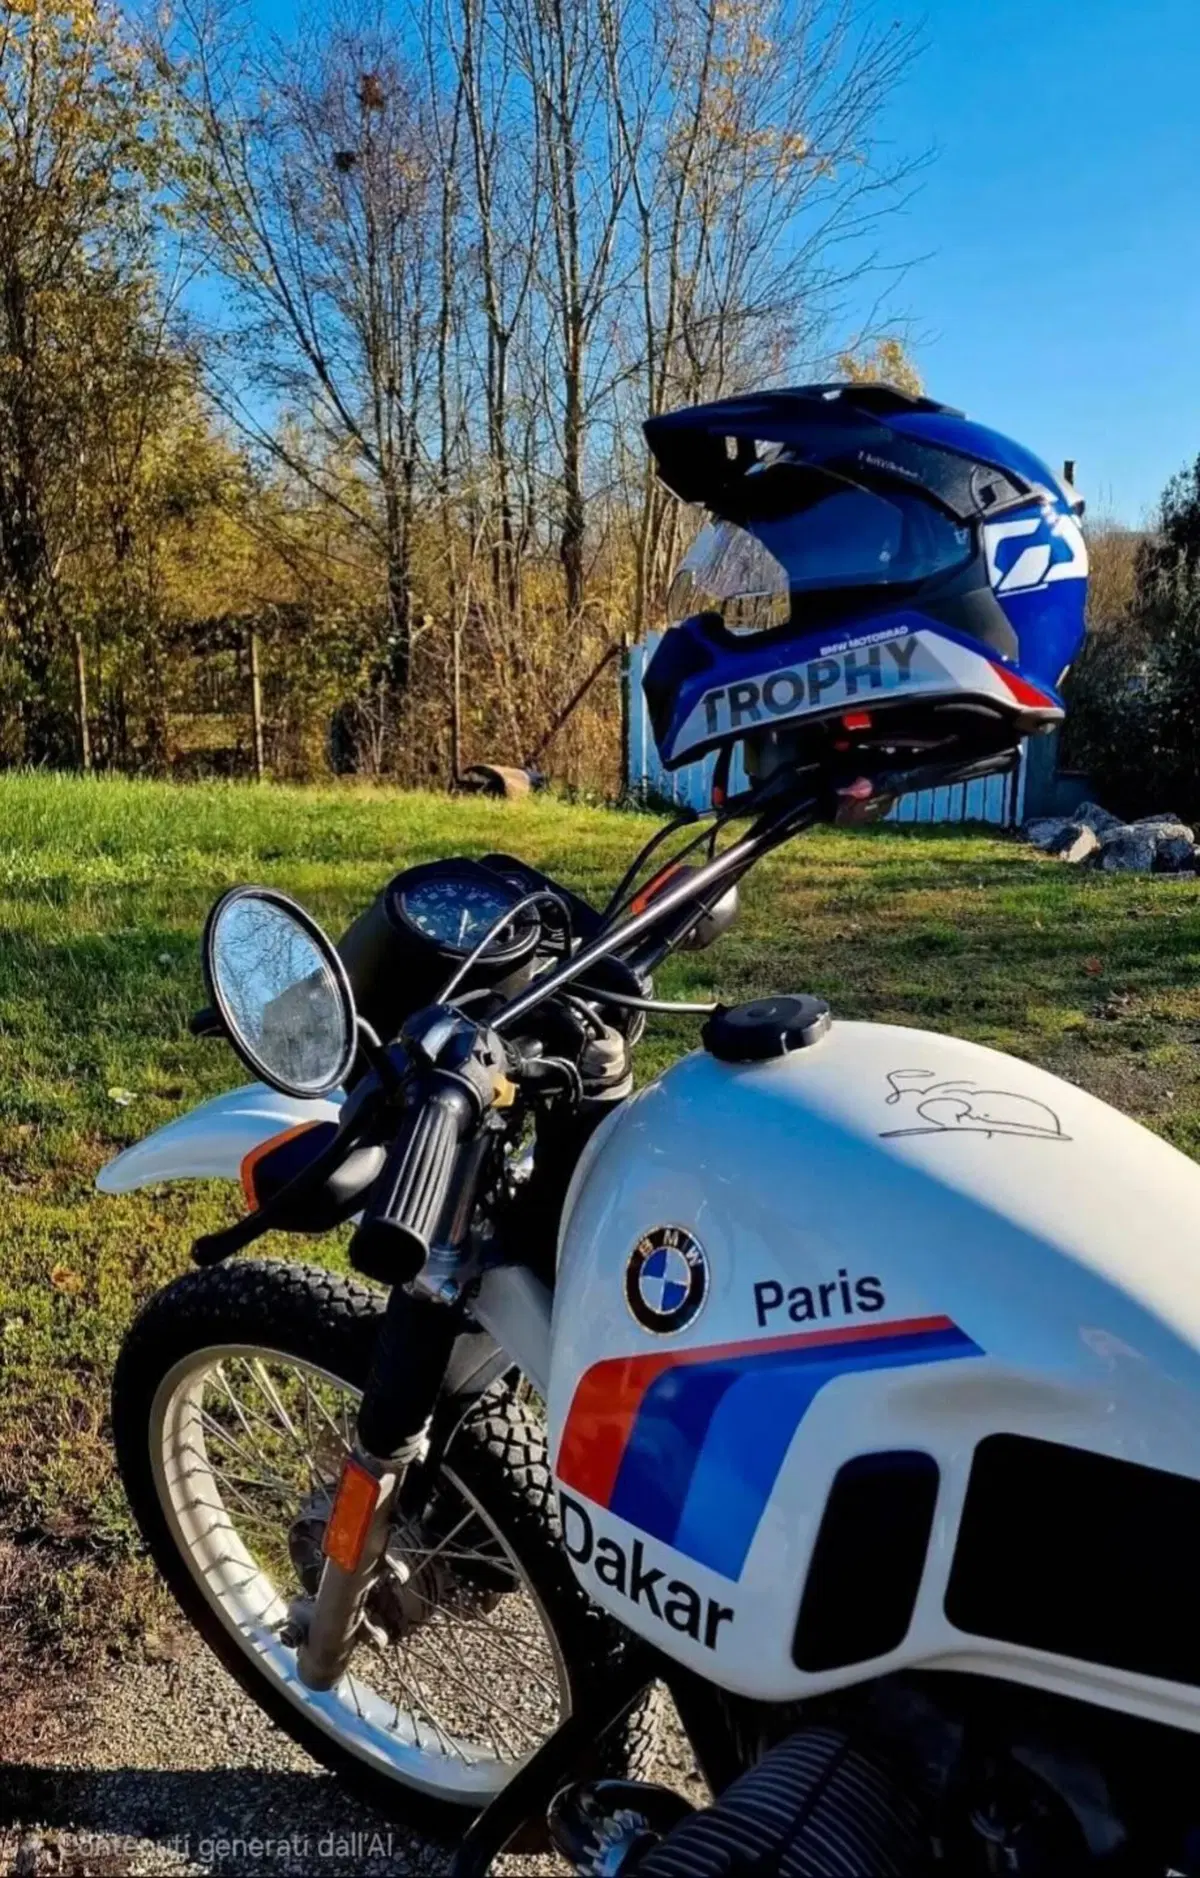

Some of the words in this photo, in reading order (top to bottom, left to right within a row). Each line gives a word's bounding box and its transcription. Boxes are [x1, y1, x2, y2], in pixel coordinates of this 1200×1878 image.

[820, 641, 848, 656] BMW
[703, 634, 919, 735] TROPHY
[638, 1228, 703, 1267] BMW
[753, 1268, 886, 1327] Paris
[559, 1489, 735, 1652] Dakar
